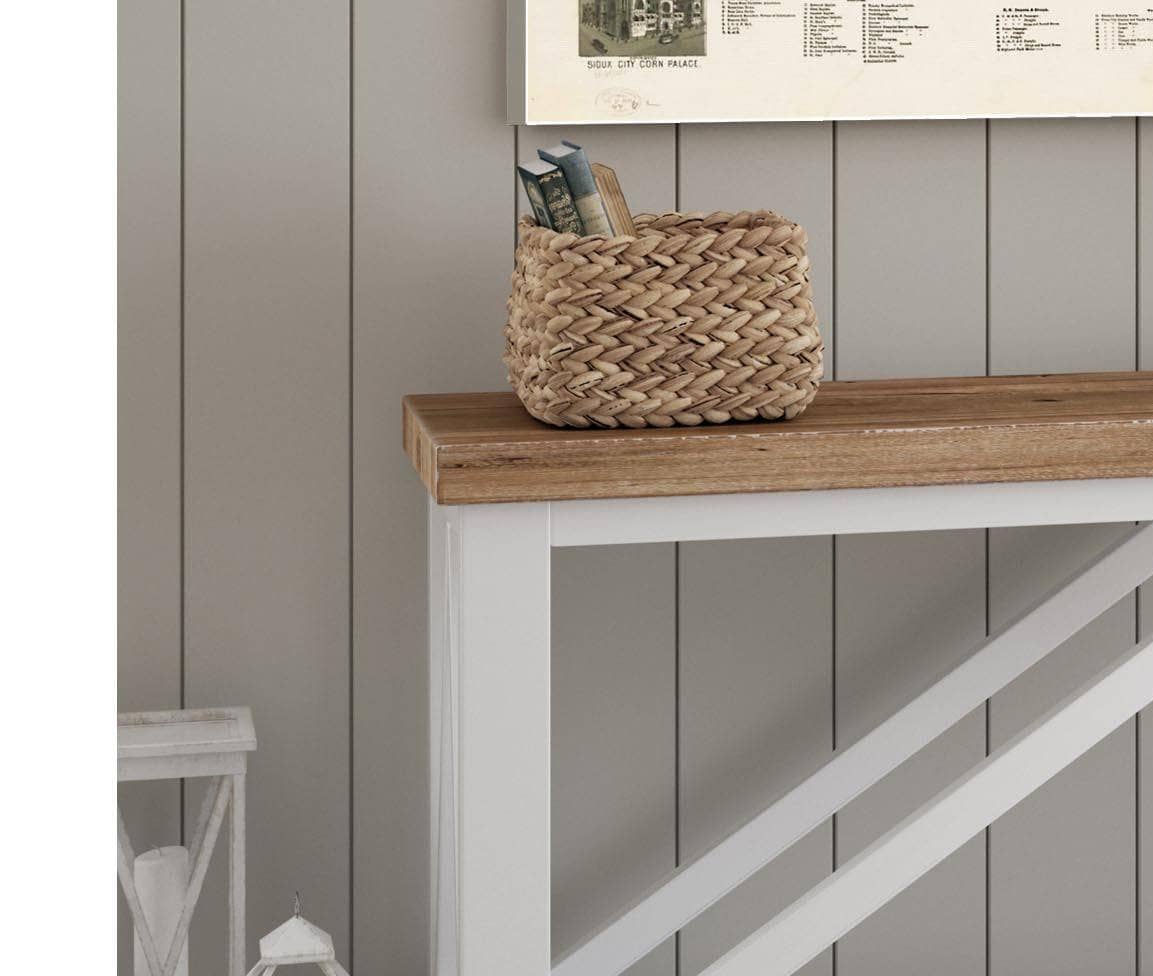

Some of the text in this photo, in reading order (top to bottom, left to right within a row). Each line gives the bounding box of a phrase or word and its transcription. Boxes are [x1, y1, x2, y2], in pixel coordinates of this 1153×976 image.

[587, 60, 612, 69] SIOUX
[618, 60, 635, 69] CITY
[639, 60, 664, 69] CORN
